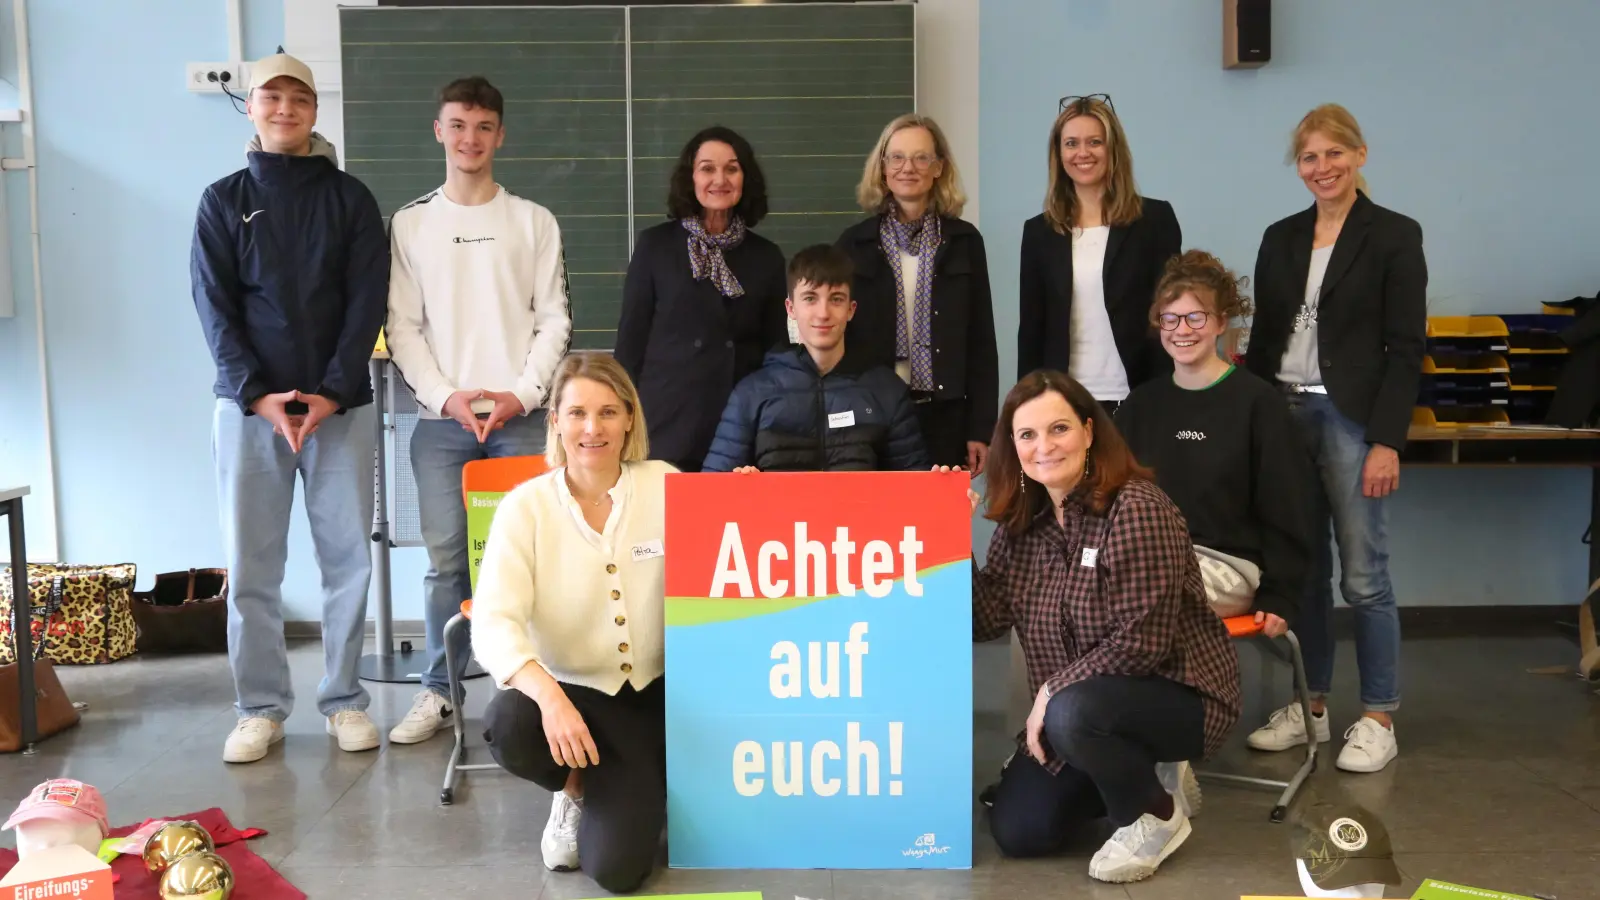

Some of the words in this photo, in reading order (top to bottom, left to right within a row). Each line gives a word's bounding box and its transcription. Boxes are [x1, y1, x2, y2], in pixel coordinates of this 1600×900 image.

[709, 521, 924, 598] Achtet
[769, 621, 869, 698] auf
[732, 721, 904, 797] euch!
